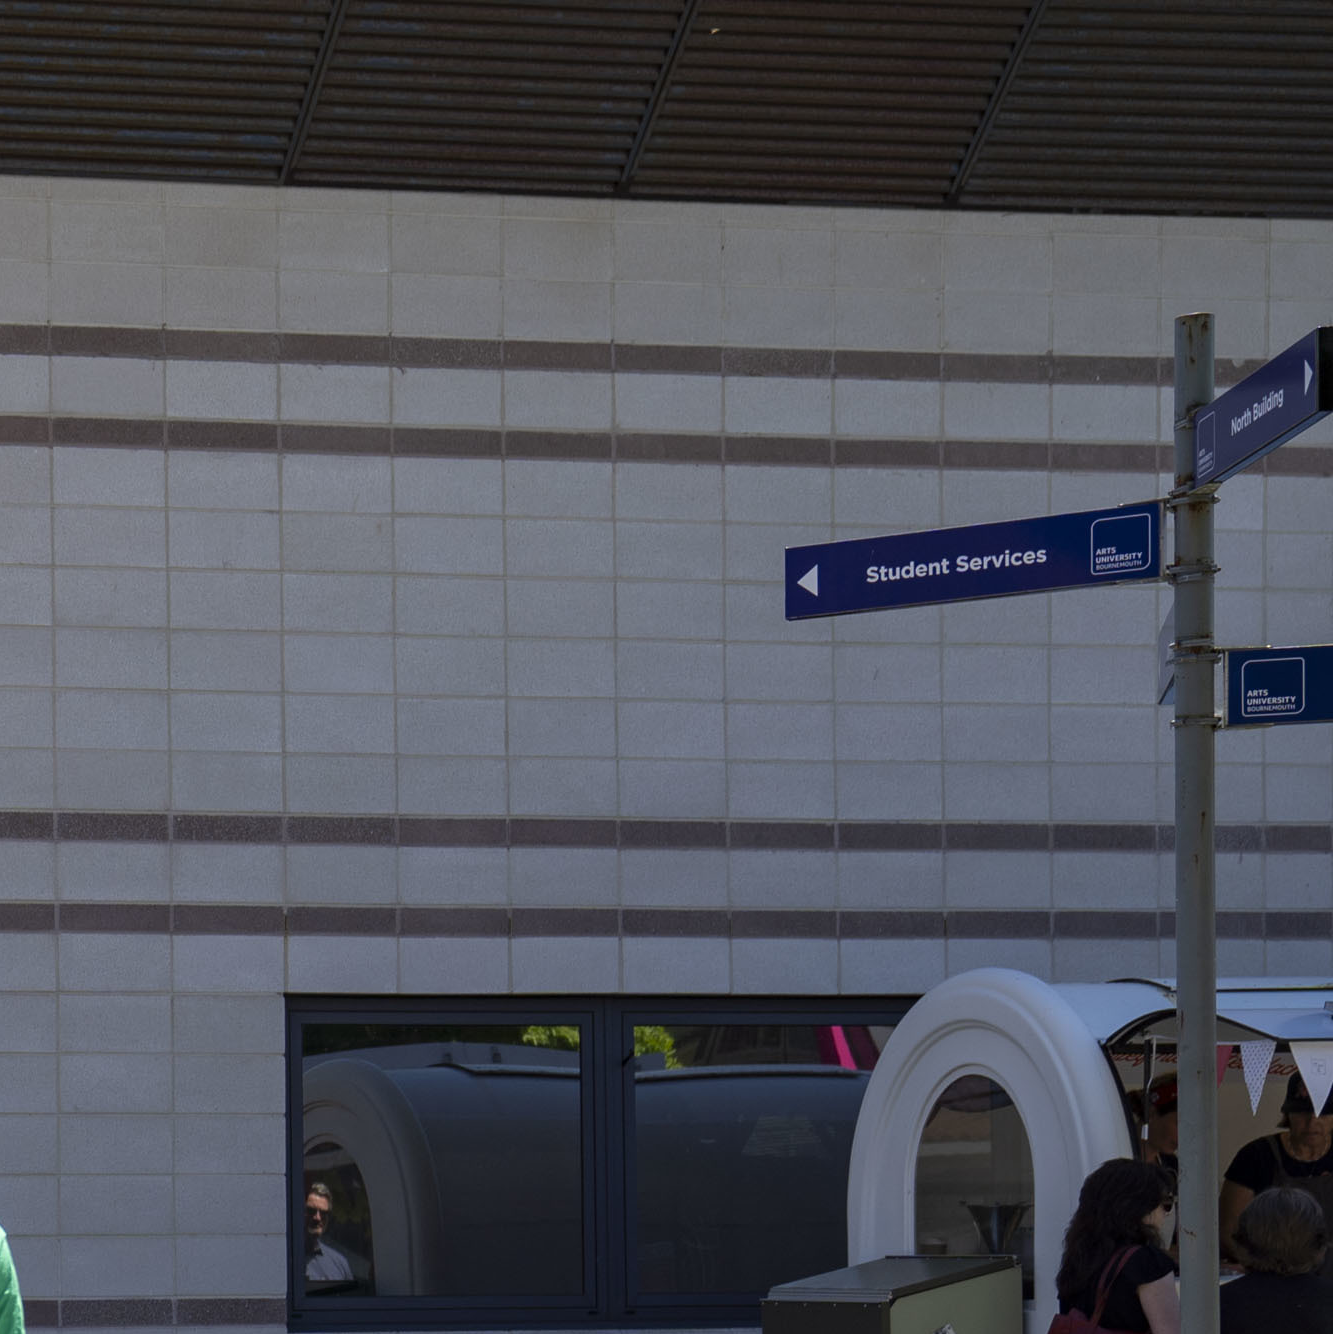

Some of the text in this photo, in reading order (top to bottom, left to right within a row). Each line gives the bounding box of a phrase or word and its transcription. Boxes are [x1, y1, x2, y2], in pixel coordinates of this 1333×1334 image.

[1231, 388, 1284, 437] North Building
[1095, 546, 1117, 556] ARTS
[1095, 551, 1143, 564] UNIVERSITY
[866, 549, 1047, 583] Student Services
[1095, 560, 1142, 571] BOURNEMOUTH
[1247, 689, 1269, 698] ARTS
[1246, 695, 1297, 706] UNIVERSITY
[1247, 704, 1296, 713] BOURNEMOUTH
